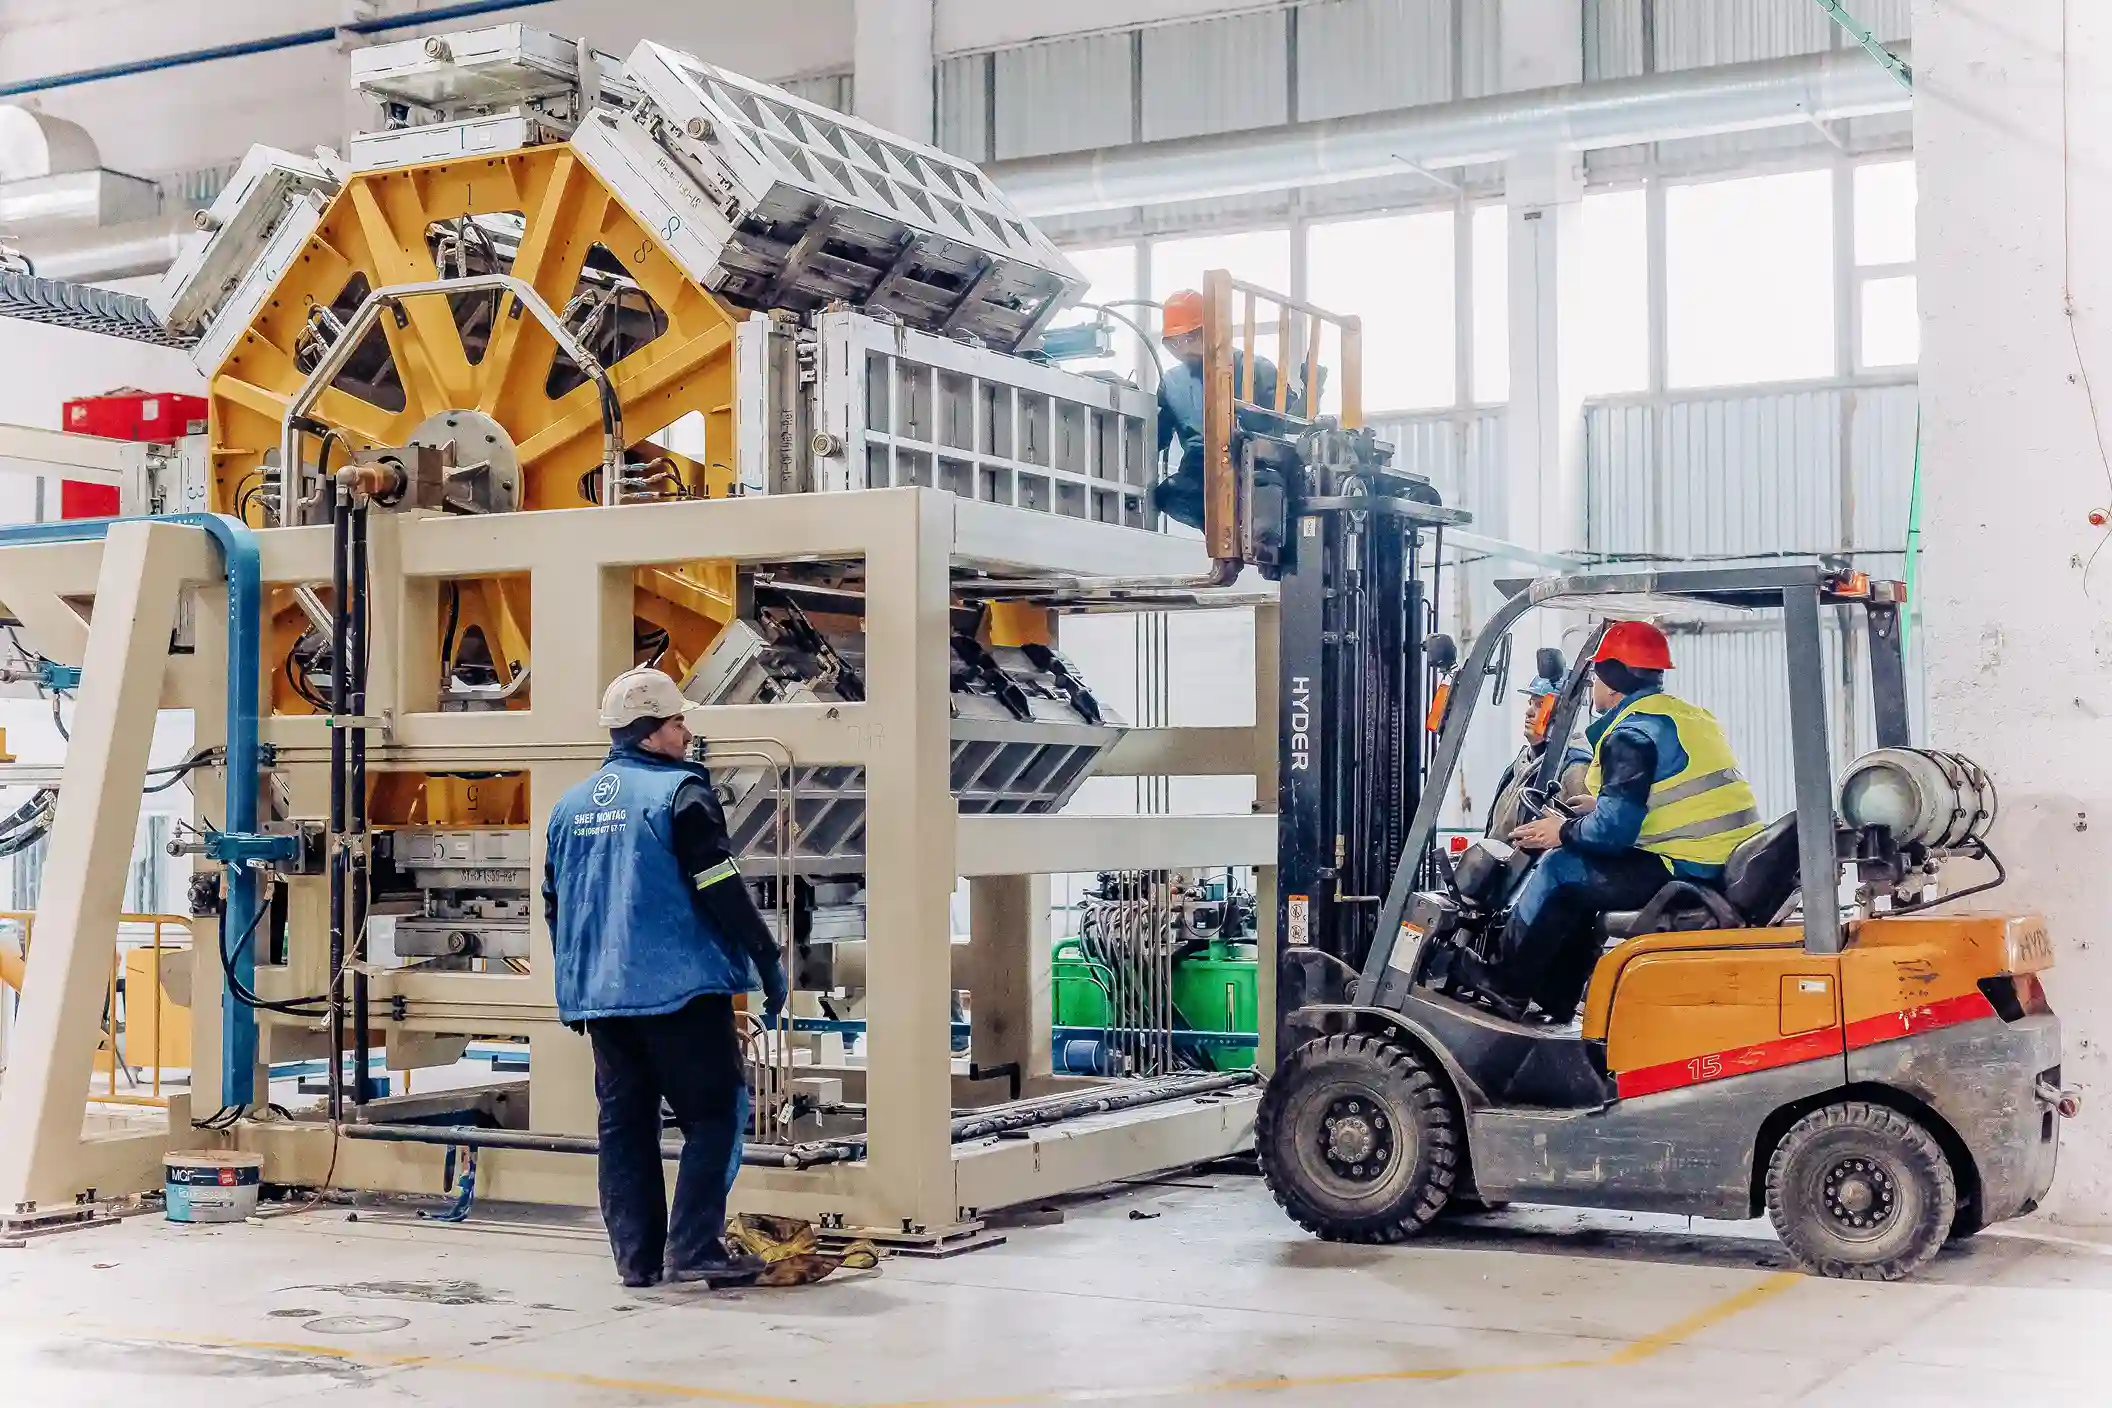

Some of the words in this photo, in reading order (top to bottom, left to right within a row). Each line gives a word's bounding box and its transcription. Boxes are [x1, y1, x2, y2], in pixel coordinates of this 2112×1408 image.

[661, 216, 681, 241] 8
[634, 239, 653, 264] 8
[1291, 677, 1310, 771] HYDER
[574, 812, 595, 825] SHEF
[597, 809, 626, 822] MONTAG
[1687, 1054, 1723, 1080] 15
